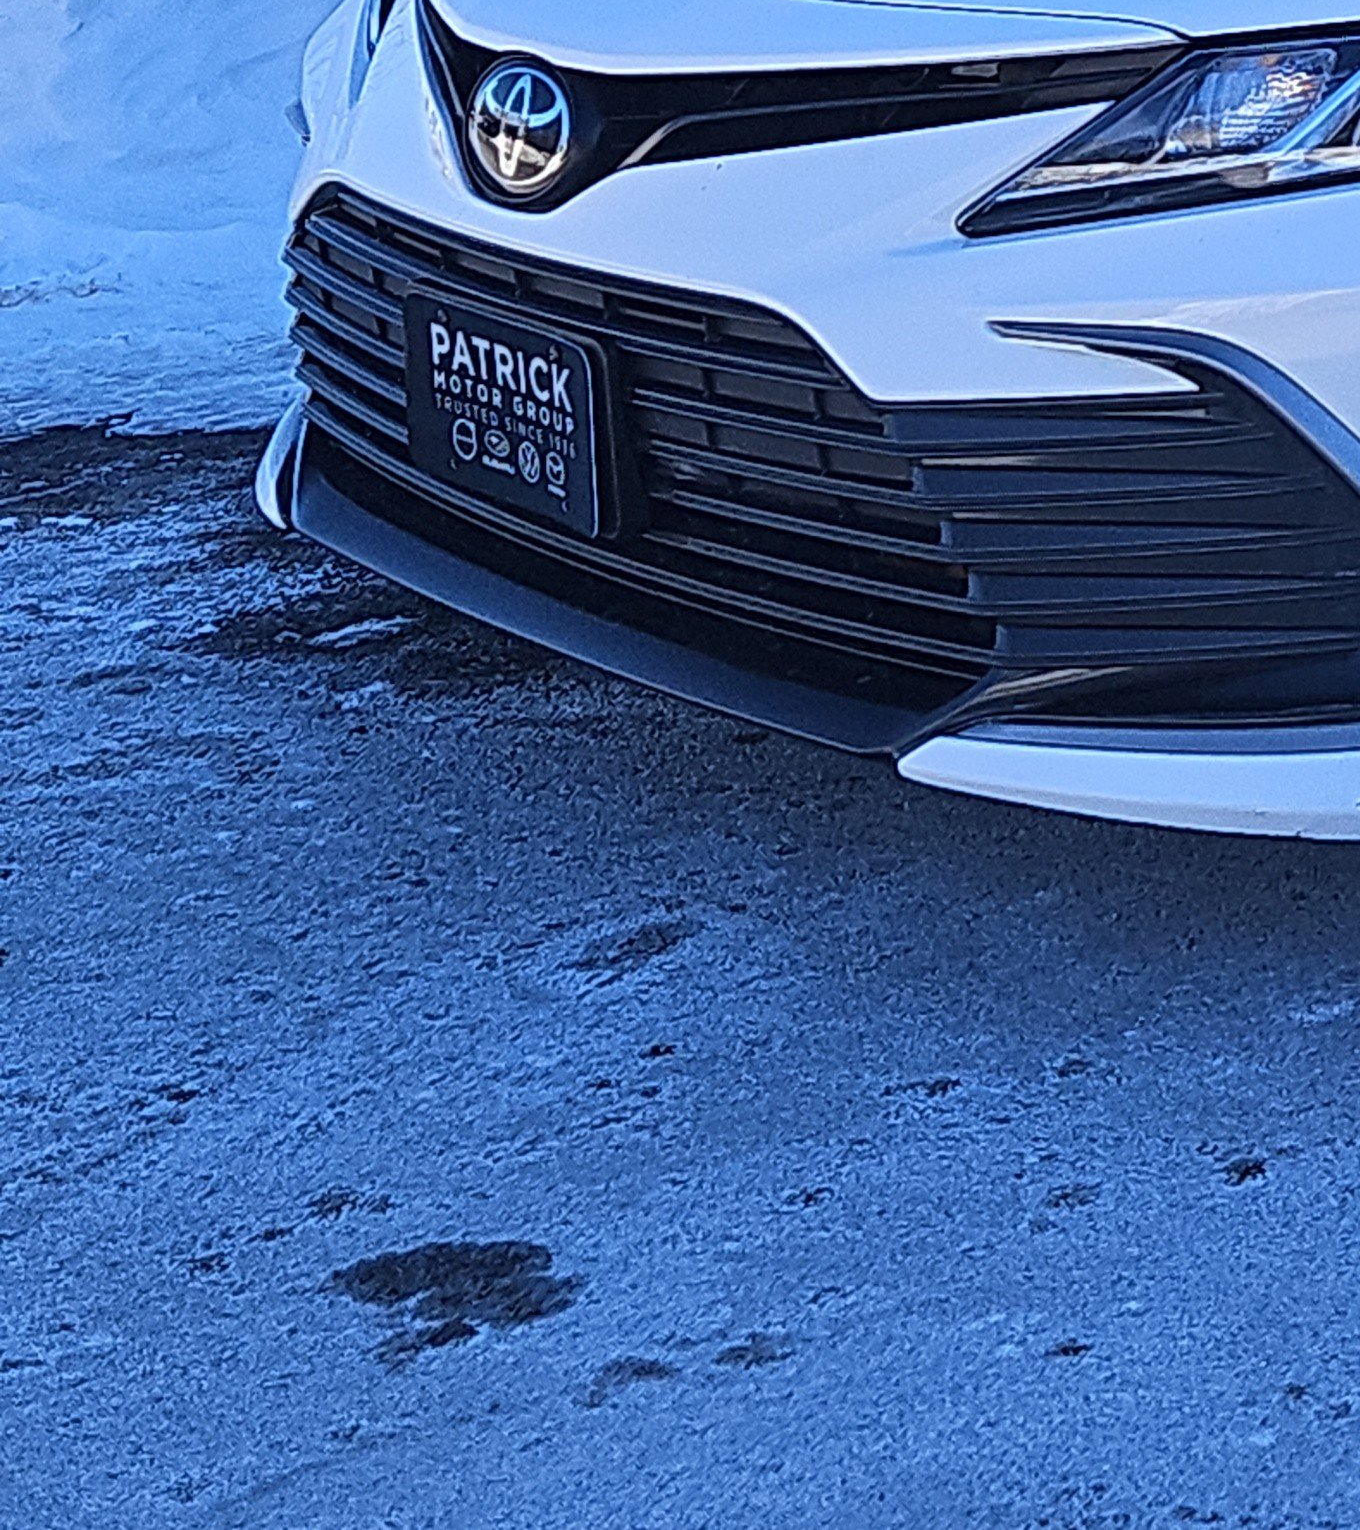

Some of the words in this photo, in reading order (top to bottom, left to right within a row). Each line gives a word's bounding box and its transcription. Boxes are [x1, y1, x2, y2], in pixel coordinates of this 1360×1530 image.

[430, 322, 573, 413] PATRICK
[433, 369, 503, 409] MOTOR
[512, 395, 575, 436] GROUP
[435, 392, 499, 427] TRUSTED
[504, 416, 544, 444] SINCE
